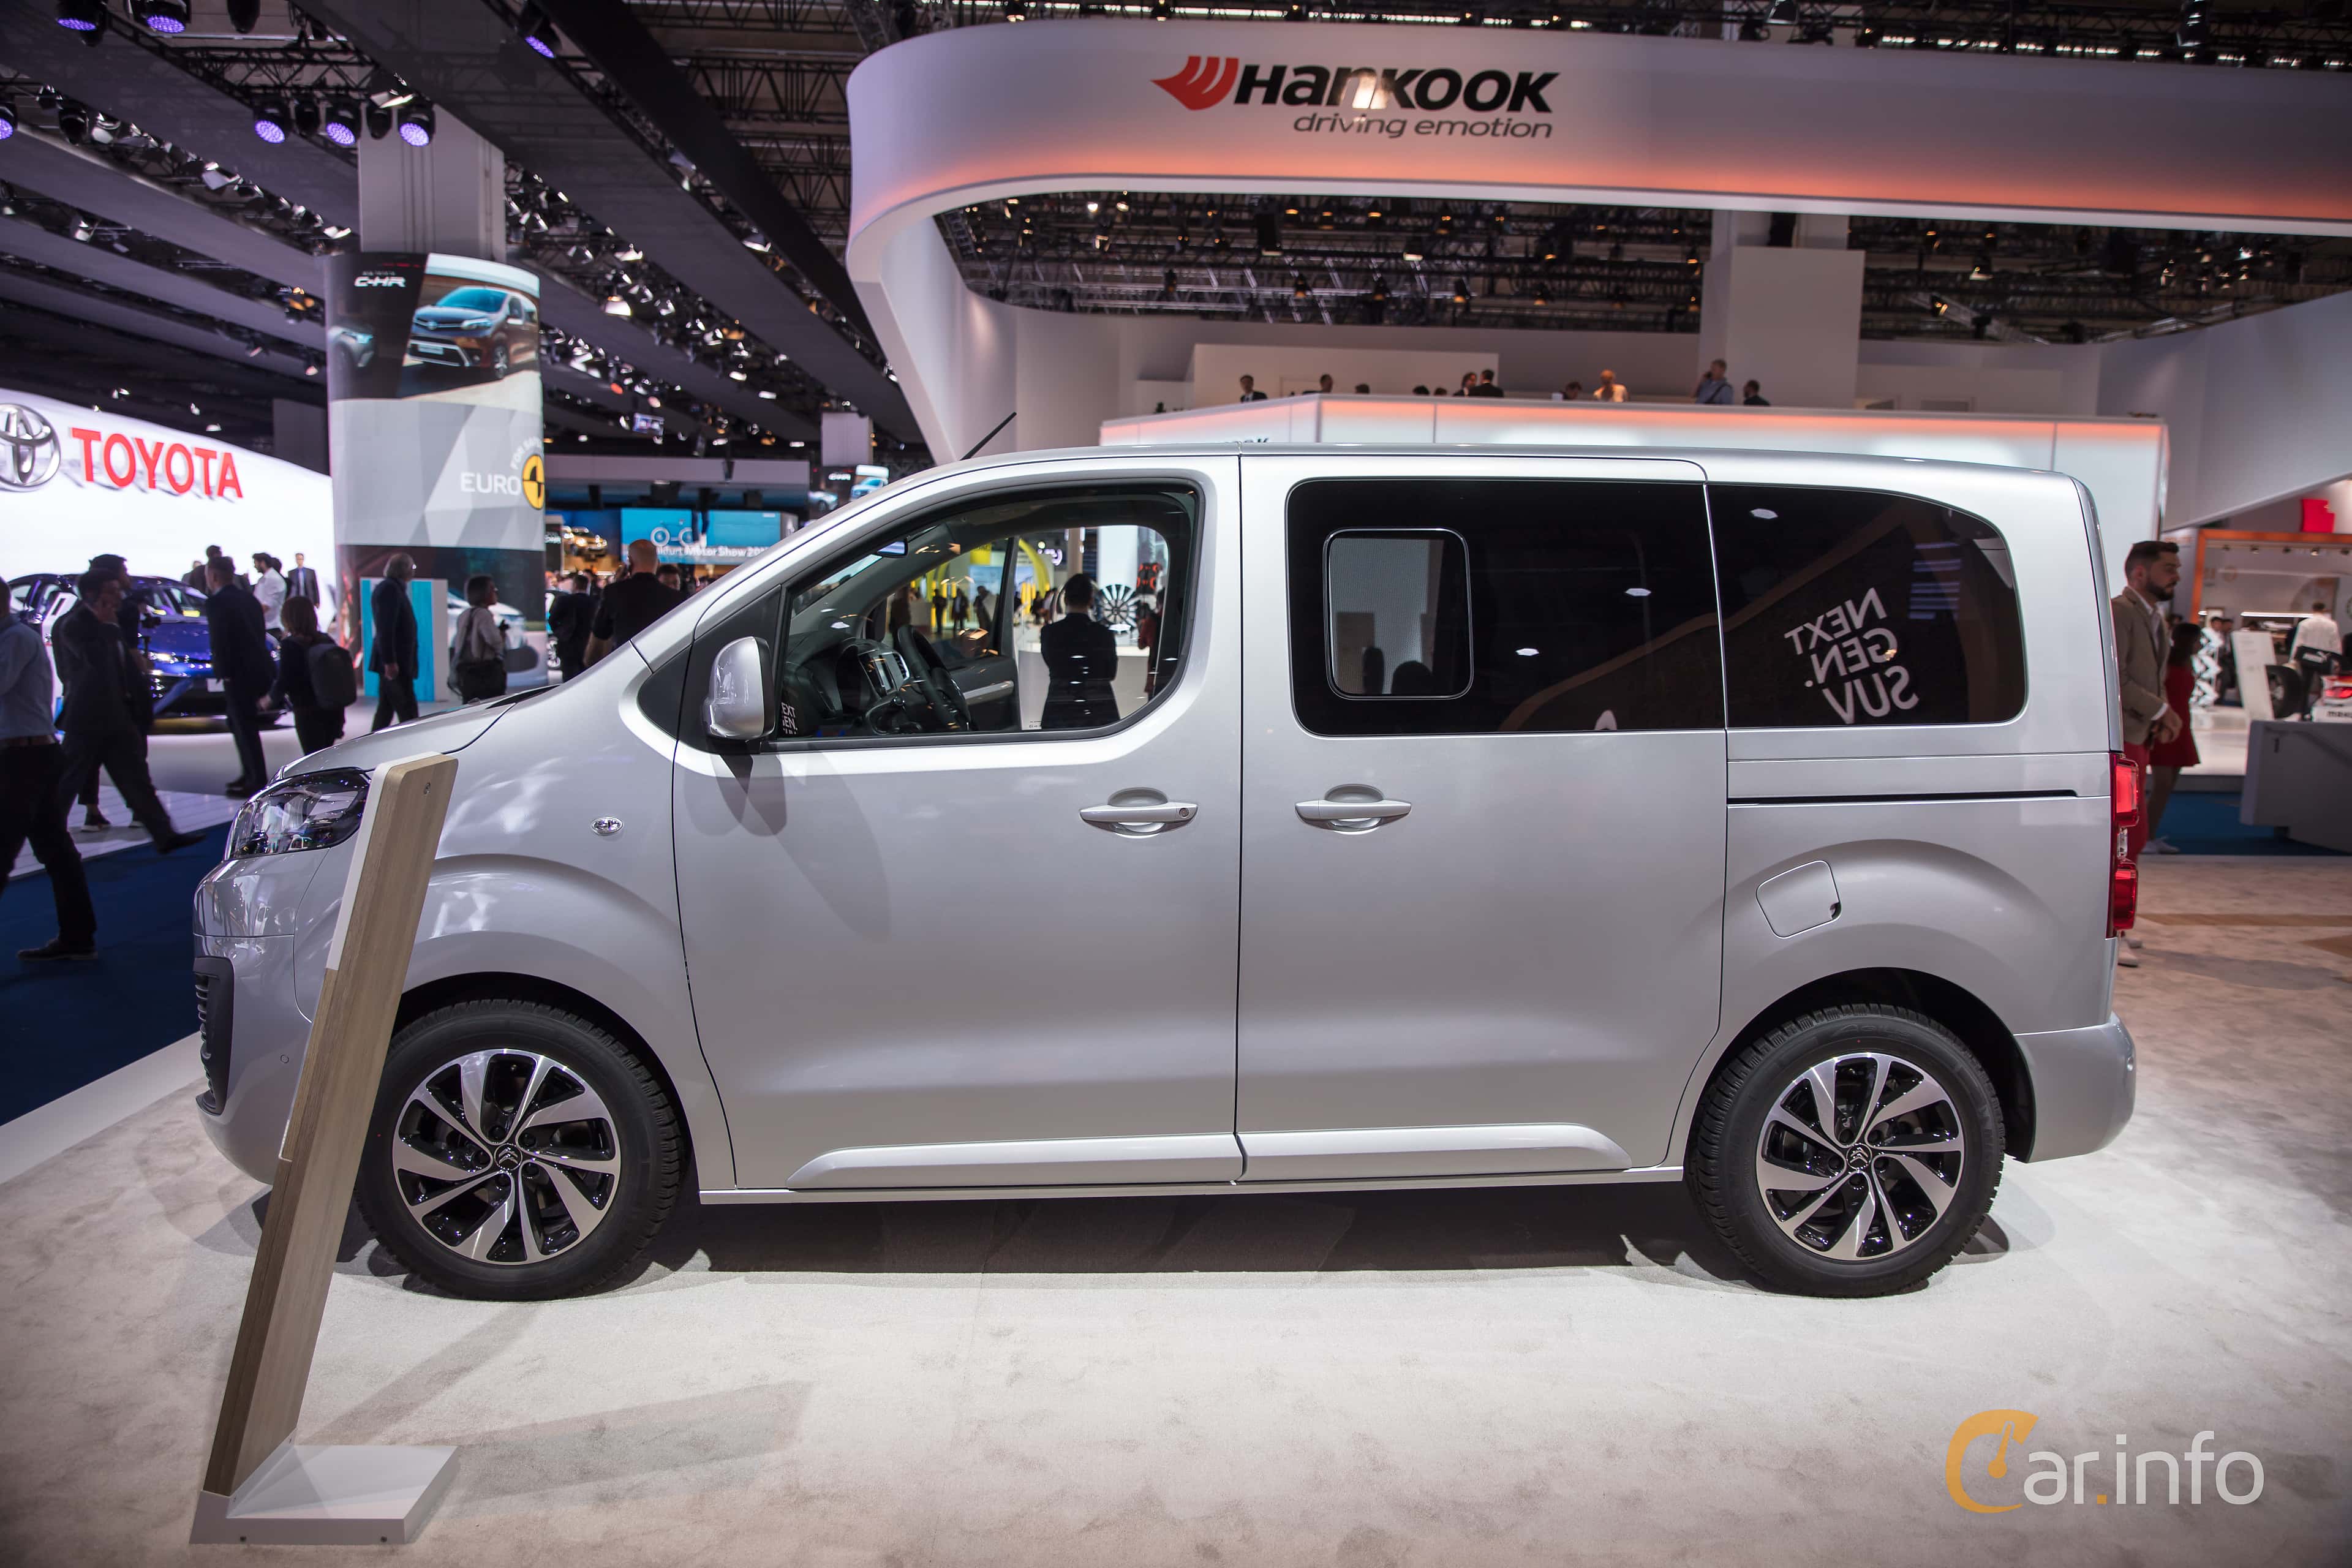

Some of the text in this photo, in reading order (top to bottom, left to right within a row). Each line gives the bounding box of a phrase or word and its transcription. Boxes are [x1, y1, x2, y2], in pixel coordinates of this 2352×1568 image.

[1293, 113, 1553, 138] driving emotion
[71, 427, 243, 498] TOYOTA
[460, 472, 521, 496] EURO
[718, 546, 746, 557] Show
[781, 702, 796, 718] EXT
